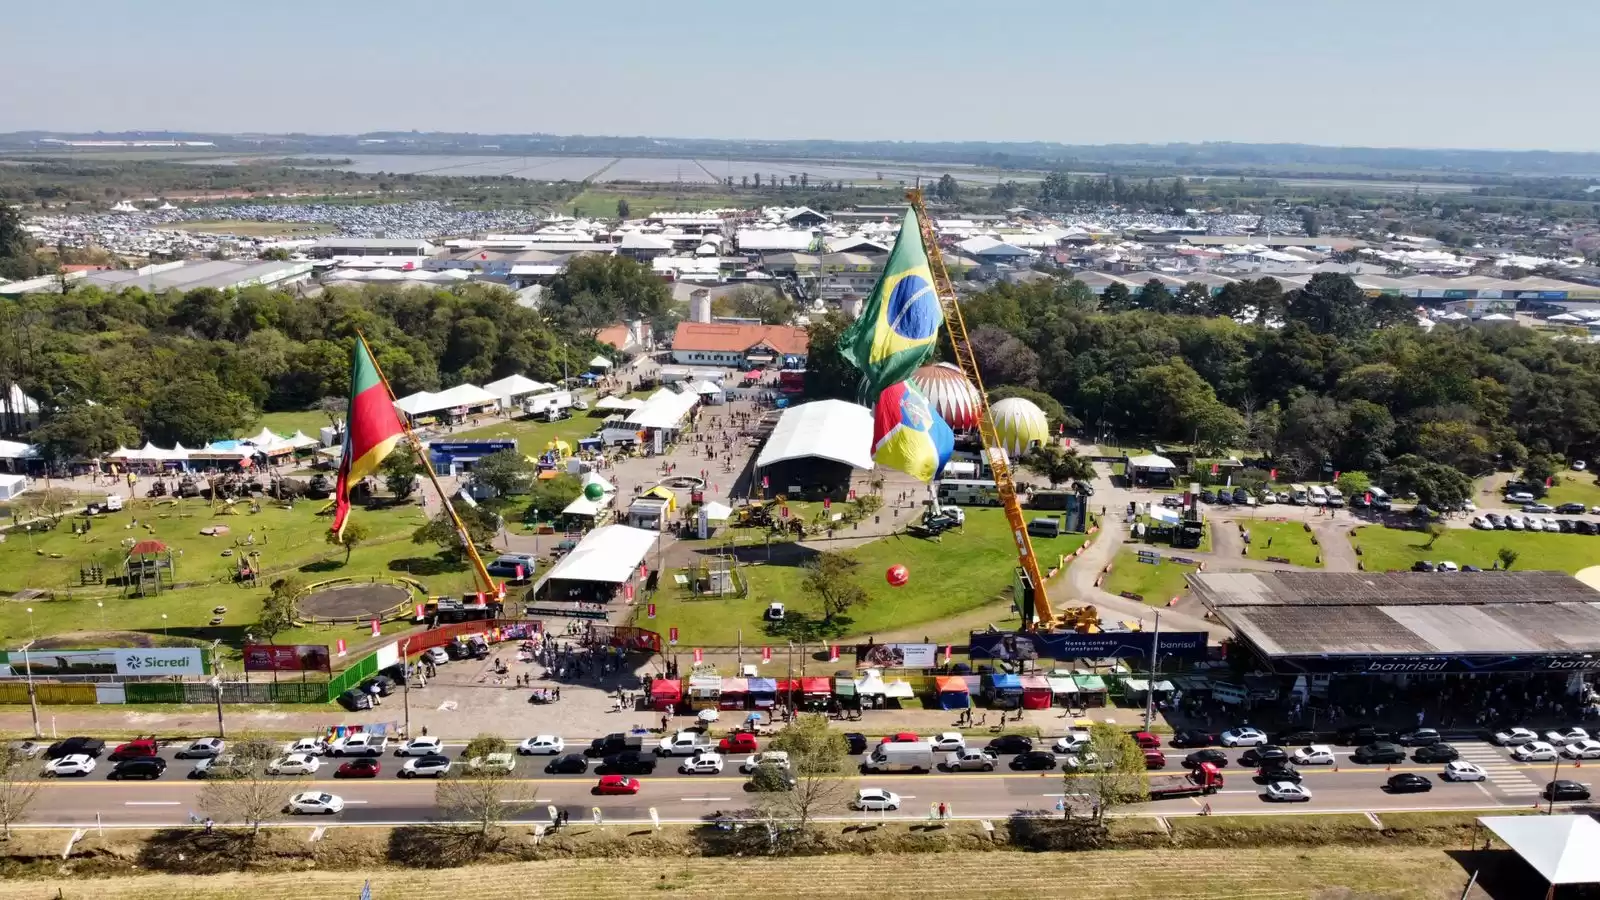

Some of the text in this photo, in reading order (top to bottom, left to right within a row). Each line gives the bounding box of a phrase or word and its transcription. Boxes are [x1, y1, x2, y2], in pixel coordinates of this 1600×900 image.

[1160, 641, 1196, 649] banrisul
[144, 656, 190, 668] Sicredi
[1368, 661, 1449, 671] banrisul
